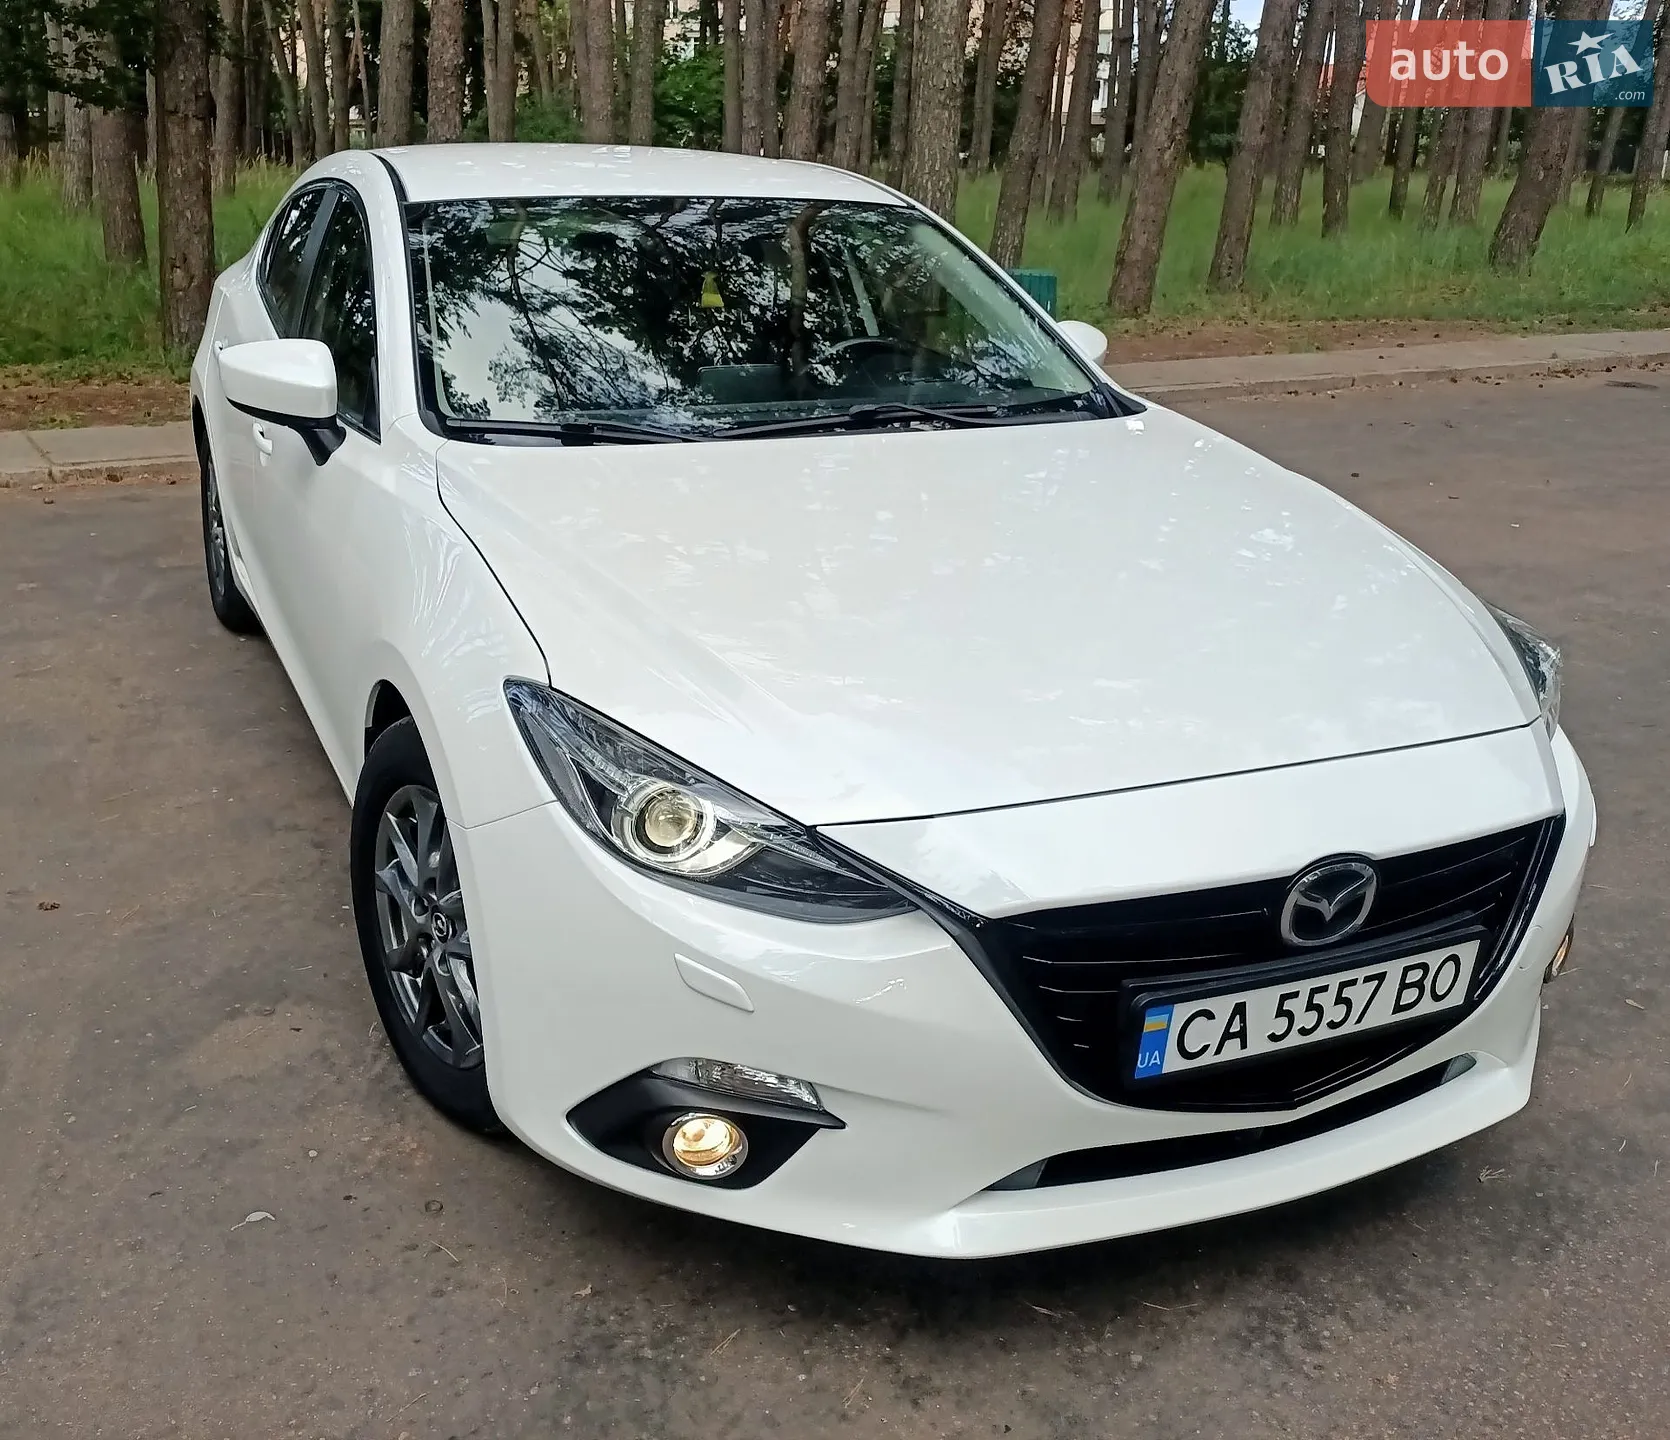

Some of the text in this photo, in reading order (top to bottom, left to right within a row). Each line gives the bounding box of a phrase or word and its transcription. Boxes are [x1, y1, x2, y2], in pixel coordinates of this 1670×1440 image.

[1176, 953, 1462, 1061] CA 5557 BO
[1137, 1051, 1161, 1068] UA
